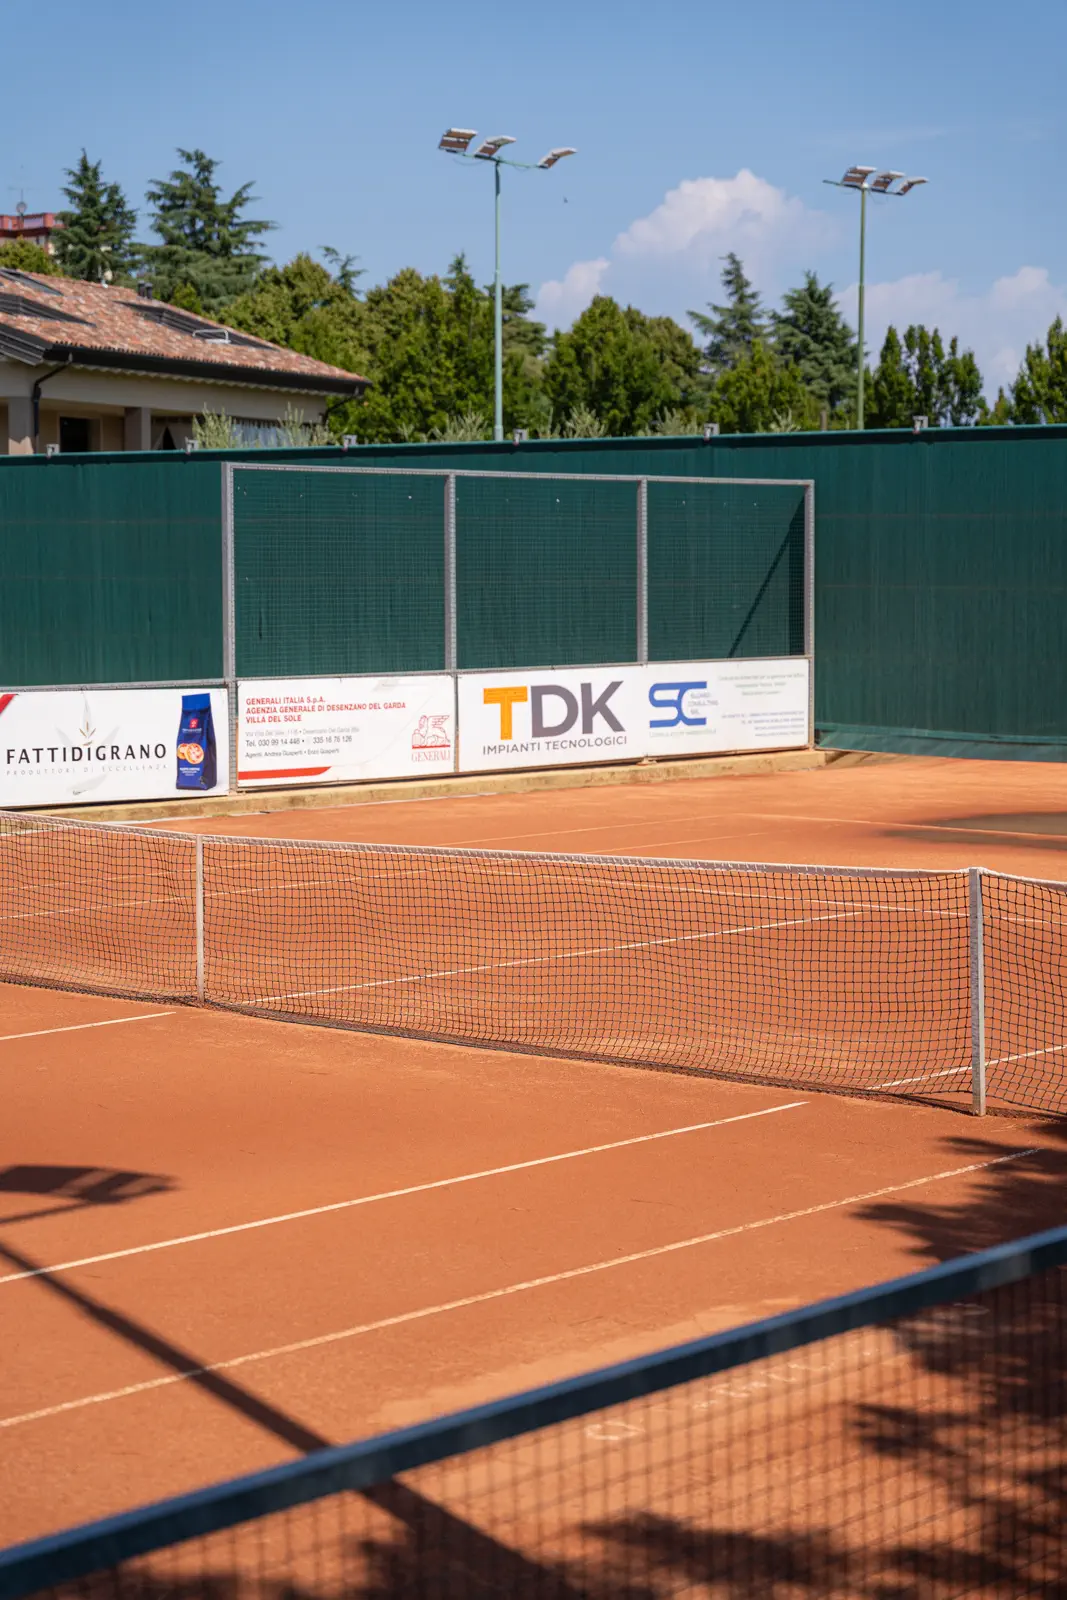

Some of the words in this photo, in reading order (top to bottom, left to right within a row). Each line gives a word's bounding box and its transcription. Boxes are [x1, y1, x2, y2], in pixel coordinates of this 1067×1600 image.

[246, 697, 282, 706] GENERALI
[283, 696, 304, 704] ITALIA
[306, 696, 326, 704] S.p.A.
[246, 706, 278, 715] AGENZIA
[279, 705, 316, 714] GENERALE
[317, 704, 325, 712] DI
[327, 703, 367, 712] DESENZANO
[369, 702, 382, 710] DEL
[384, 702, 406, 710] GARDA
[483, 680, 625, 741] TDK
[246, 716, 266, 724] VILLA
[268, 715, 282, 724] DEL
[284, 714, 302, 722] SOLE
[483, 742, 540, 756] IMPIANTI
[545, 736, 627, 750] TECNOLOGICI
[6, 743, 167, 764] FATTIDIGRANO
[411, 750, 450, 762] GENERALI
[6, 768, 76, 776] PRODUTTORI
